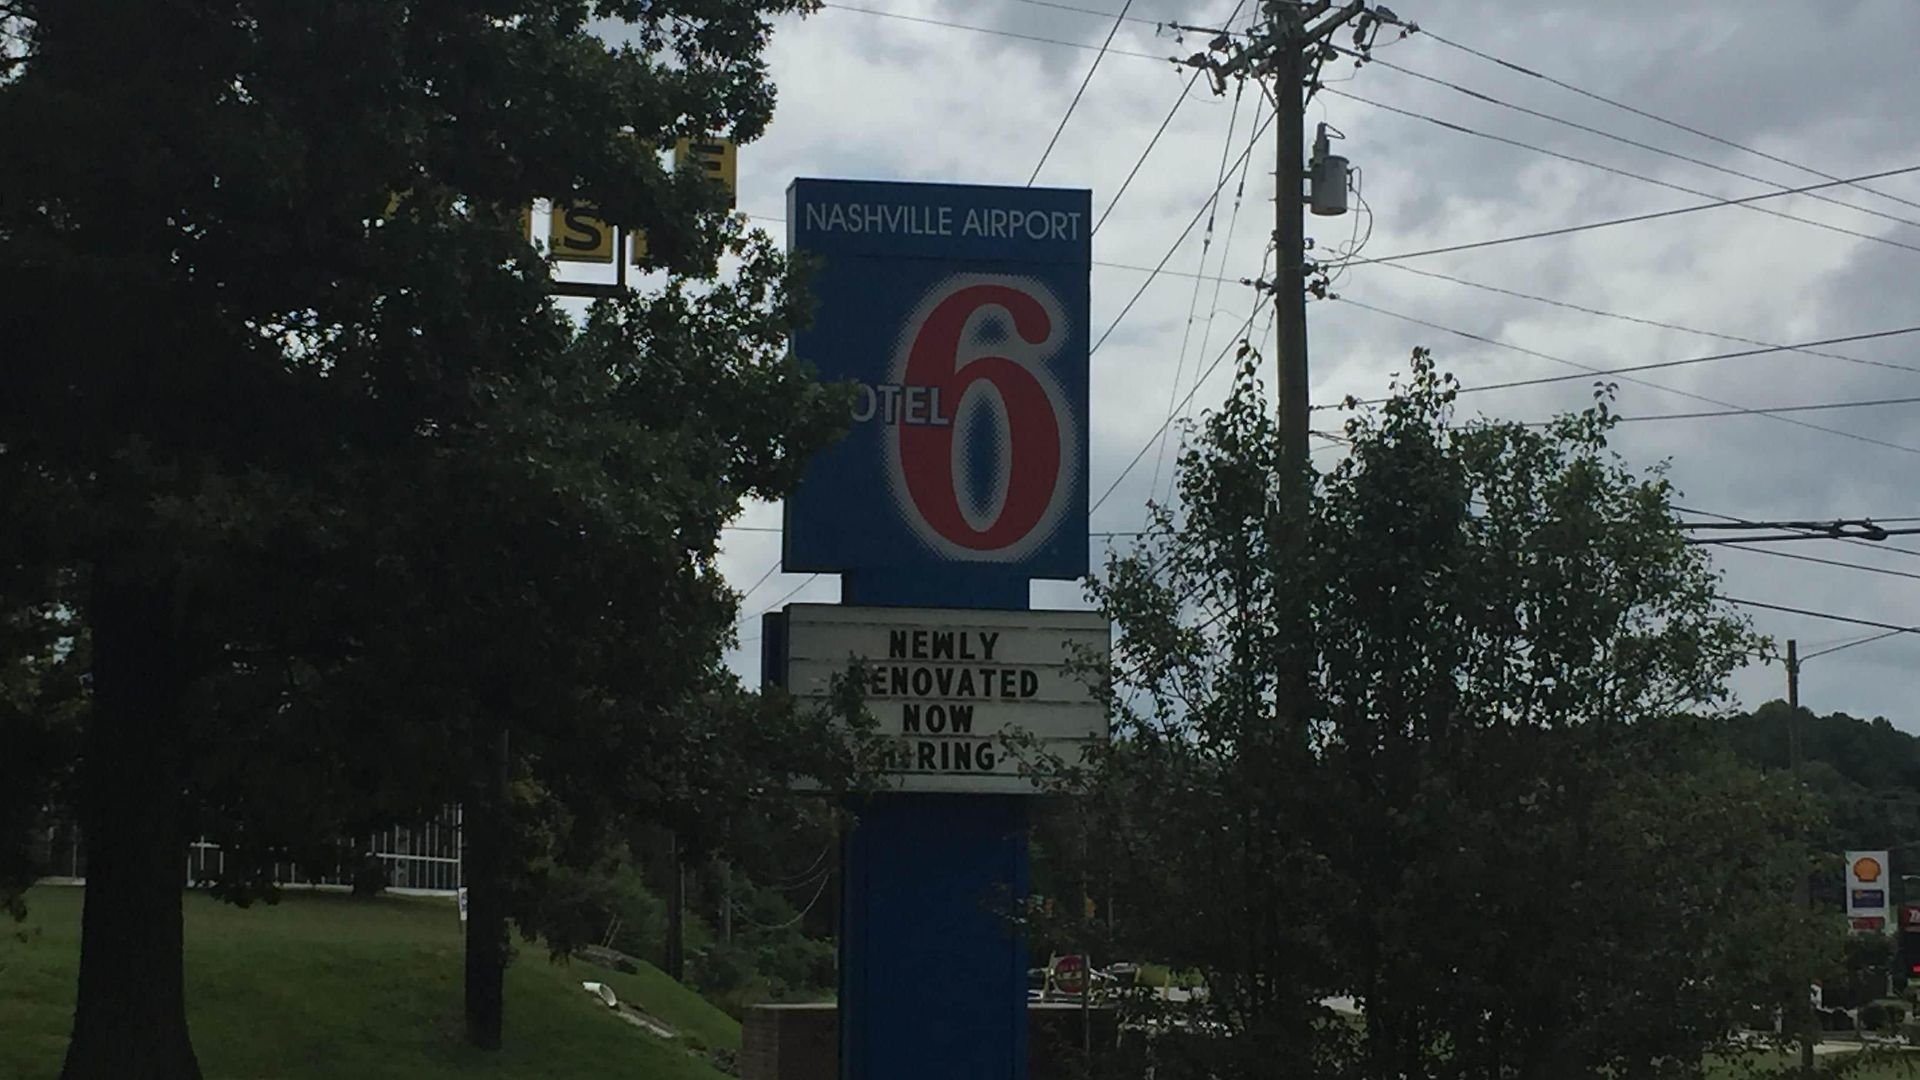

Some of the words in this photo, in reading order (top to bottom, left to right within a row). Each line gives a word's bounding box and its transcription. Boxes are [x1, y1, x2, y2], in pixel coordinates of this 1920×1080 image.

[805, 202, 953, 237] NASHVILLE
[962, 208, 1081, 241] AIRPORT
[847, 383, 950, 425] OTEL
[899, 284, 1060, 549] 6
[889, 630, 999, 661] NEWLY
[868, 666, 1039, 698] ENOVATED
[902, 703, 975, 733] NOW
